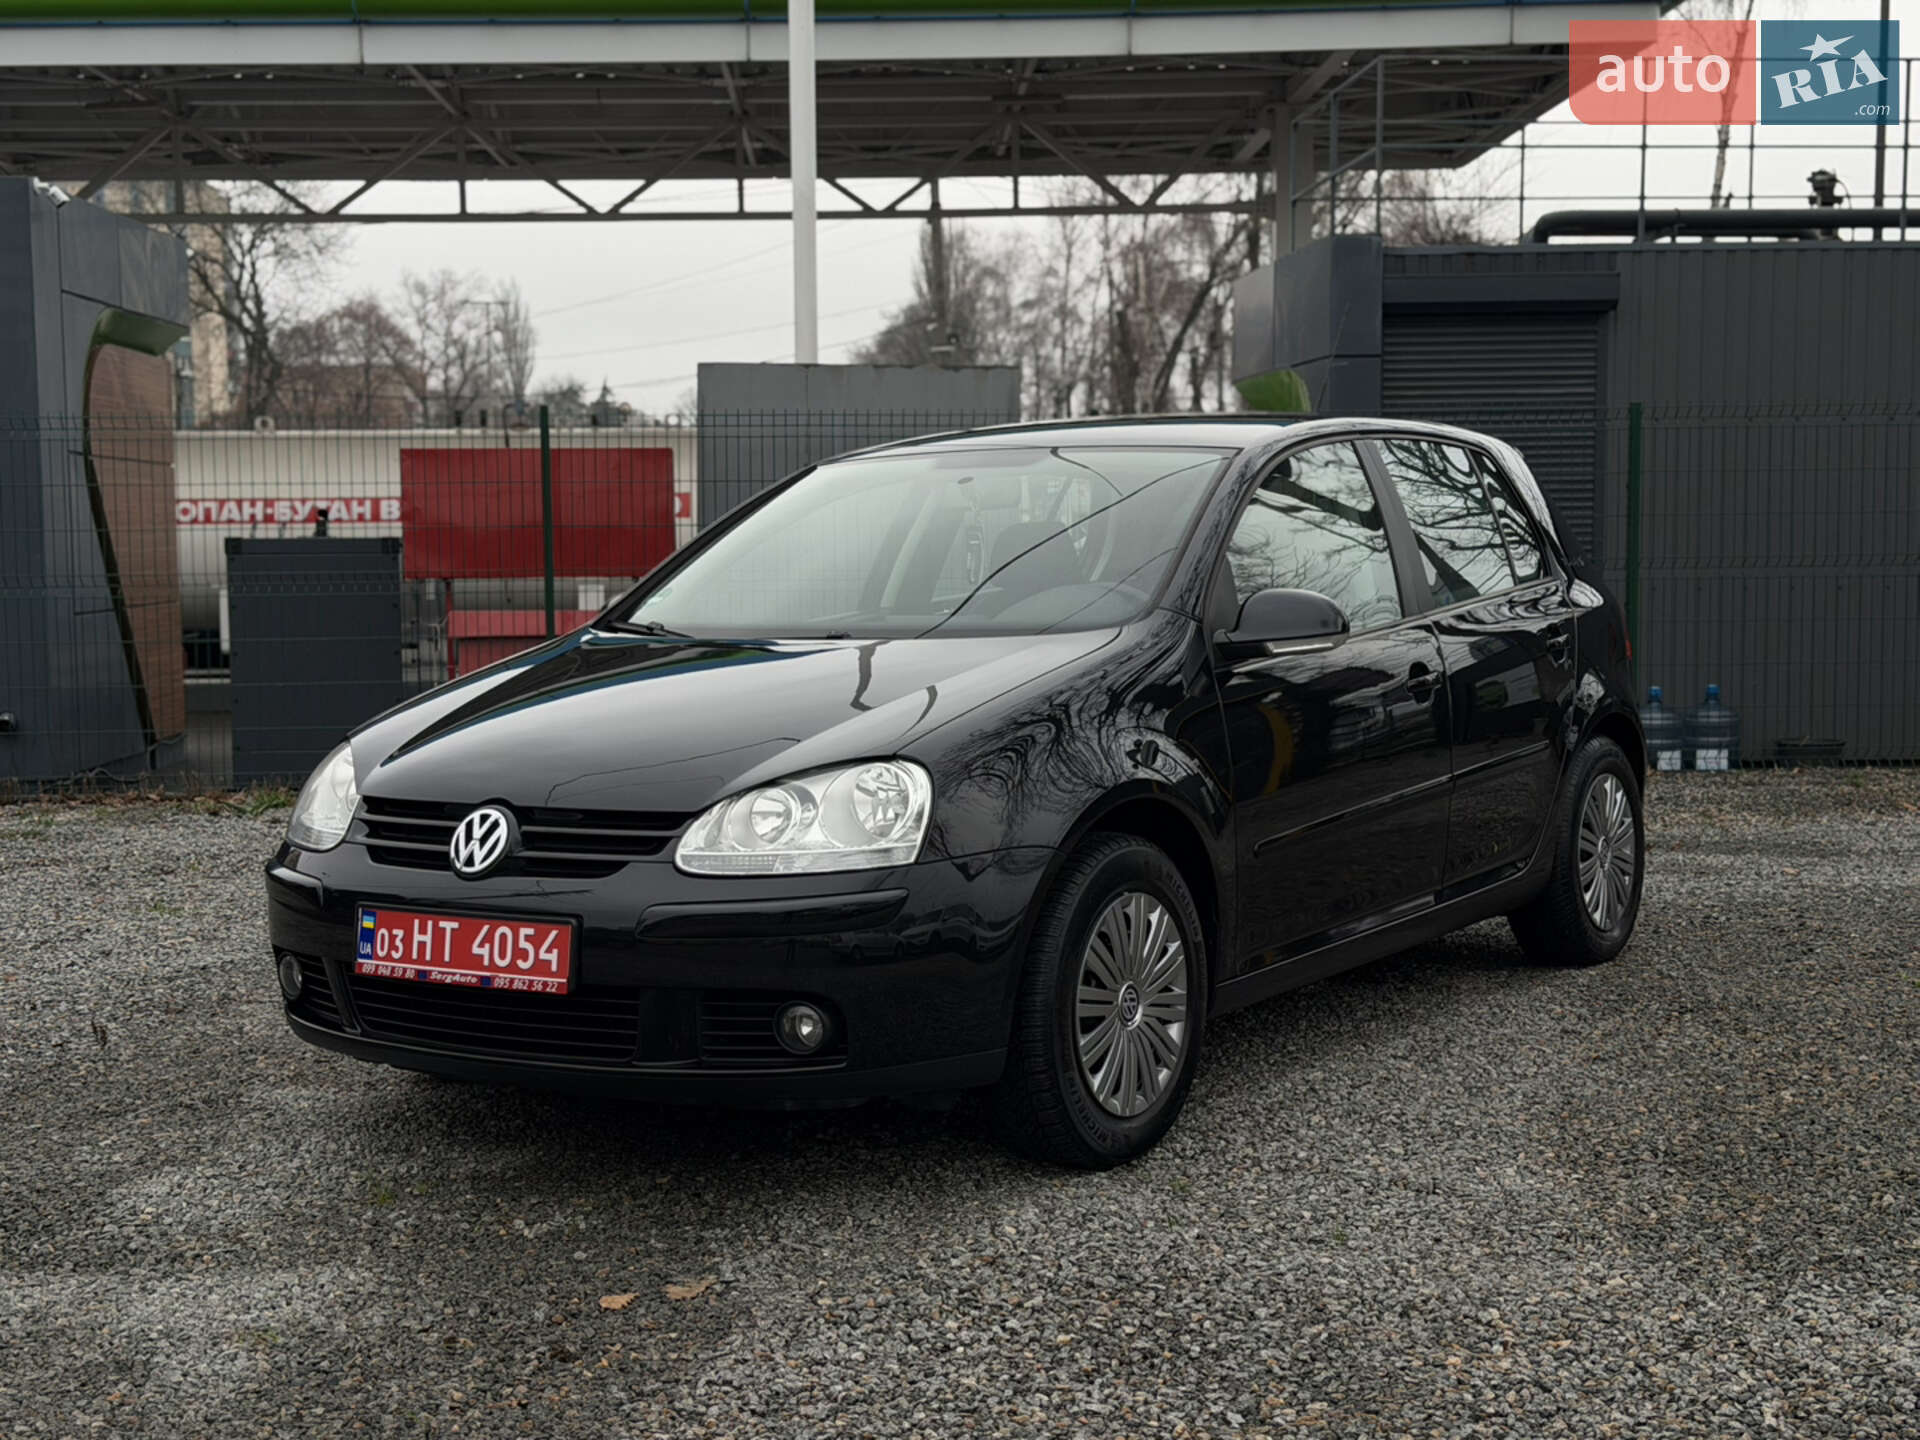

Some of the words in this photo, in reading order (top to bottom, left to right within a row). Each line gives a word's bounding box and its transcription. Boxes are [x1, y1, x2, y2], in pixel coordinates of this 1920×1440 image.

[359, 941, 372, 956] UA
[376, 927, 404, 960] 03
[412, 918, 459, 962] HT
[471, 924, 559, 972] 4054
